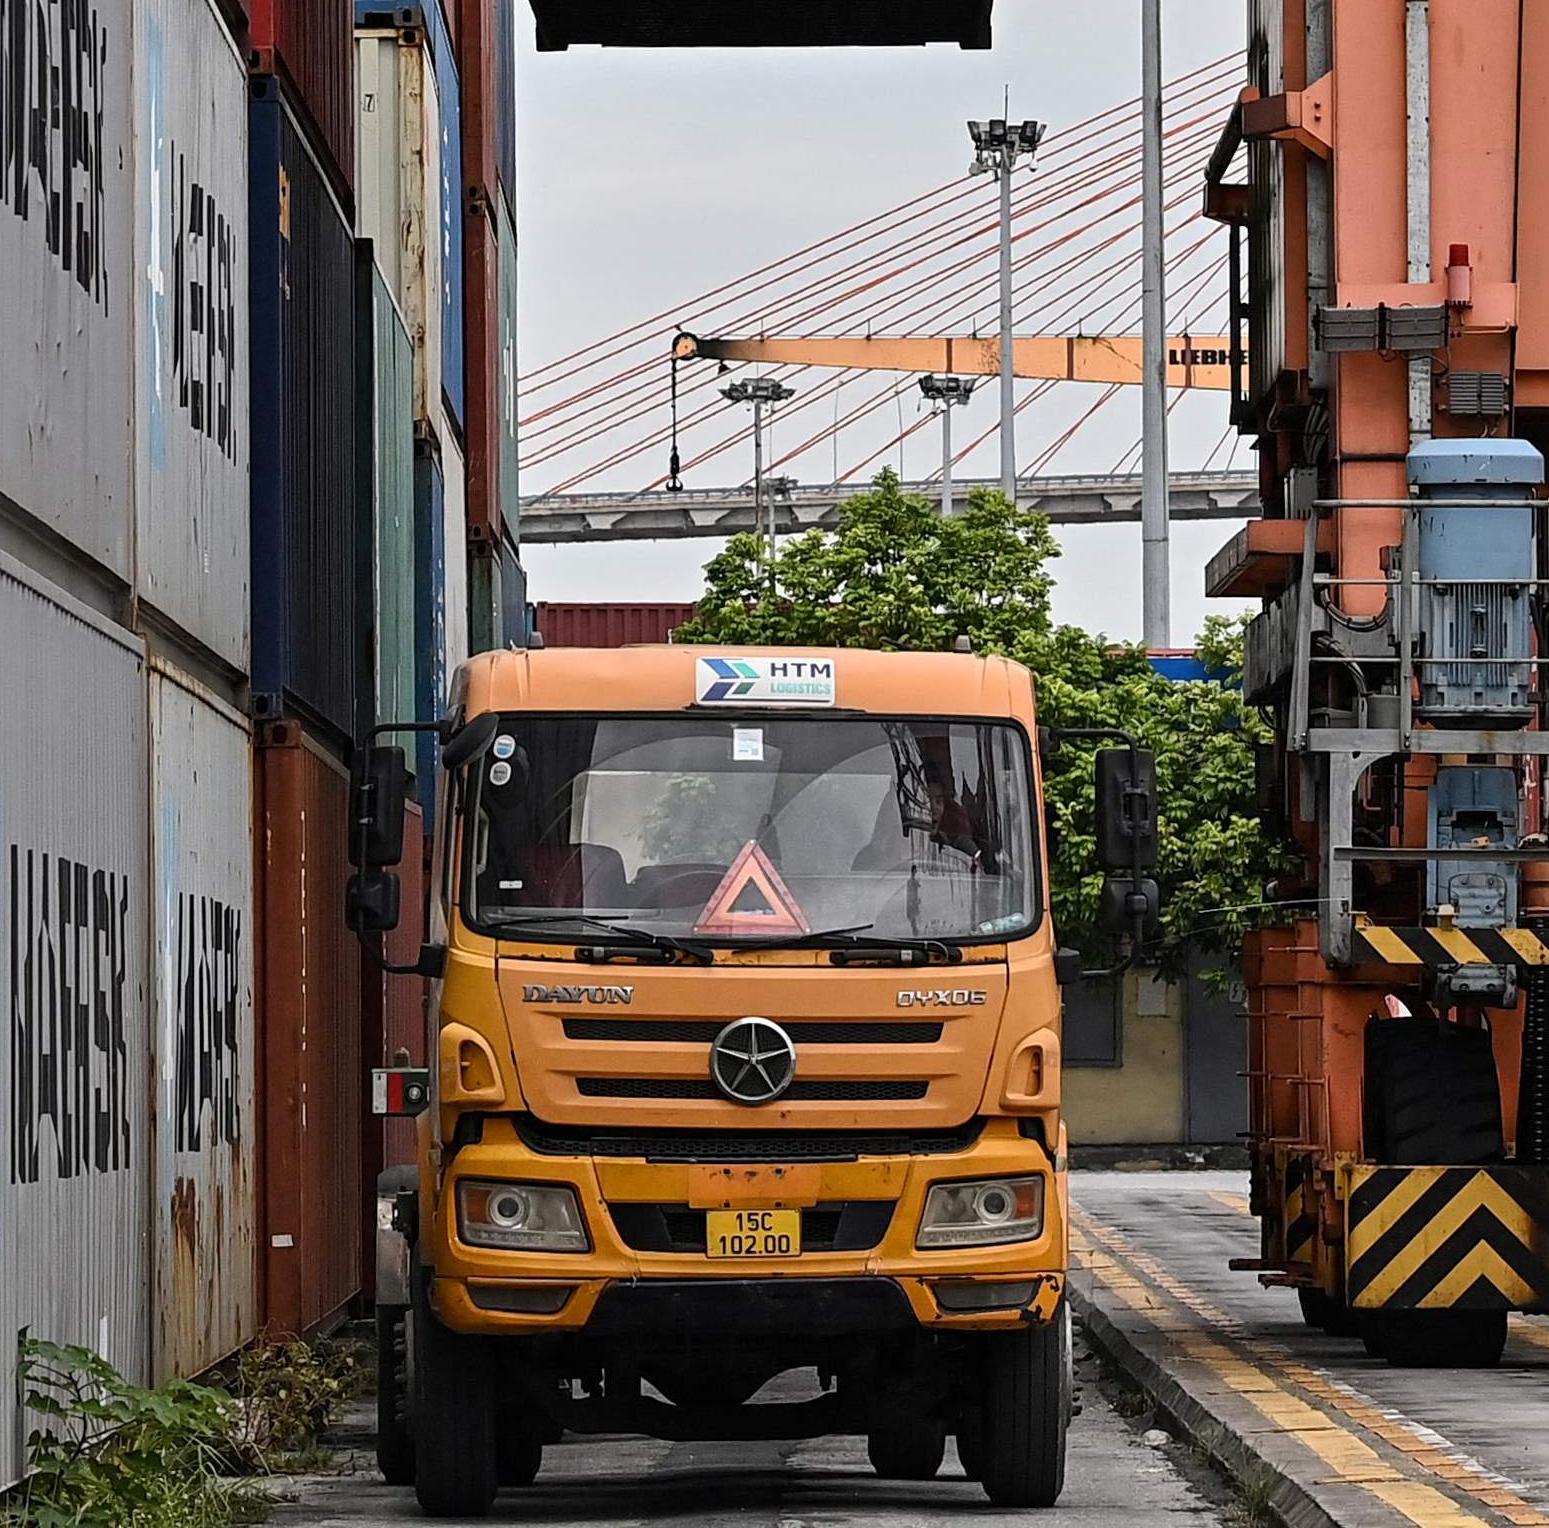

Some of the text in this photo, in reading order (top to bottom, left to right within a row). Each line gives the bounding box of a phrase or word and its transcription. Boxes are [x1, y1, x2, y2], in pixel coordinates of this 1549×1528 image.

[770, 662, 831, 678] HTM
[770, 683, 831, 694] LOGISTICS
[522, 983, 634, 1004] DAYUN
[736, 1212, 773, 1232] 15C
[719, 1235, 790, 1254] 102.00
